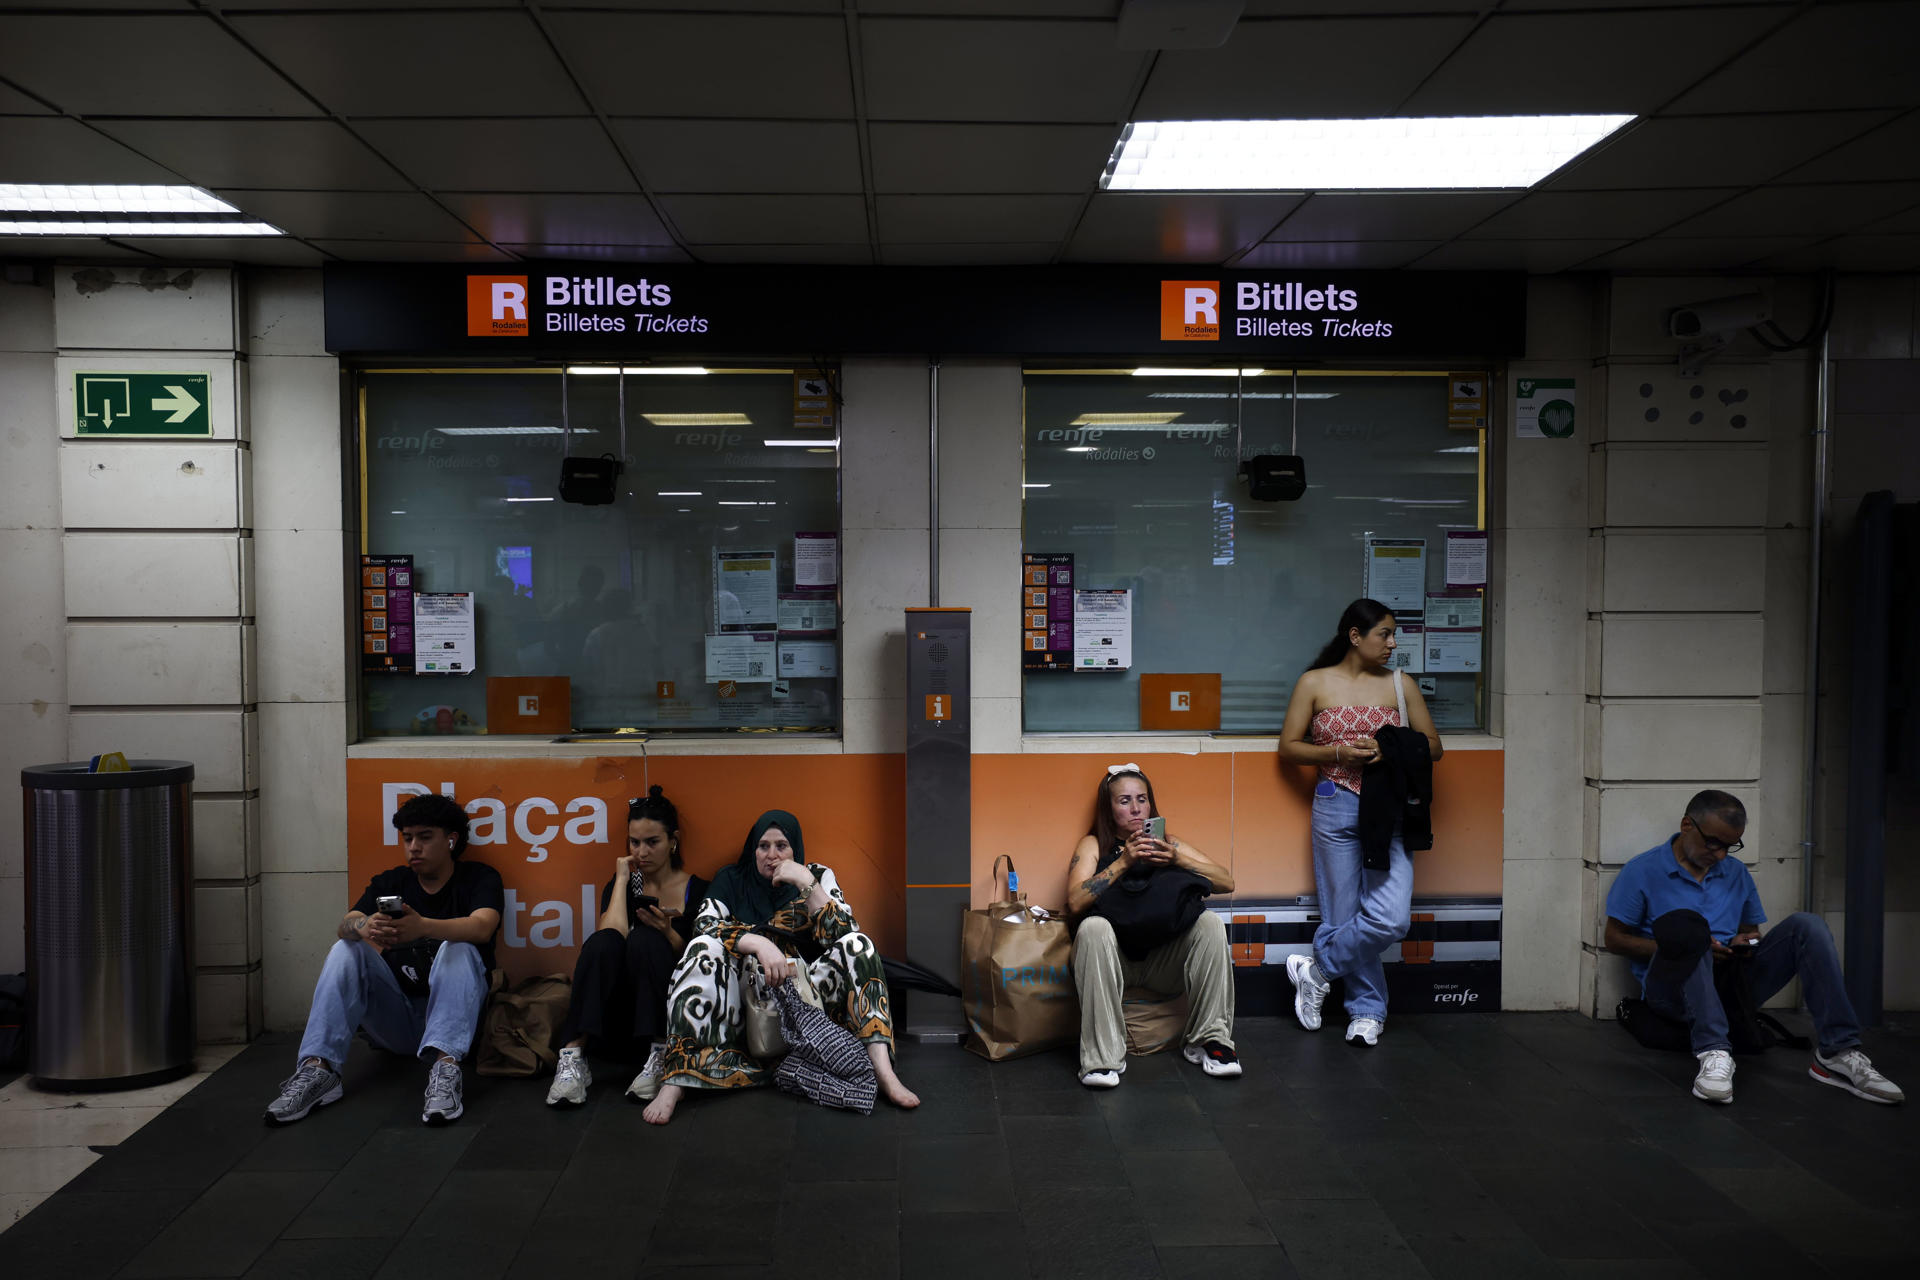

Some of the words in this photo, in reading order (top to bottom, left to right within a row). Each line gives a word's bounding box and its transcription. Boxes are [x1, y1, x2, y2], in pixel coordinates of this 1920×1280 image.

[492, 283, 526, 319] R
[546, 276, 671, 306] Bitllets
[1236, 281, 1357, 311] Bitllets
[1184, 287, 1218, 324] R
[546, 313, 625, 332] Billetes
[635, 313, 708, 333] Tickets
[1184, 326, 1217, 334] Rodalies
[1236, 317, 1313, 337] Billetes
[1322, 318, 1393, 337] Tickets
[377, 429, 445, 456] renfe
[675, 428, 742, 453] renfe
[1037, 424, 1103, 446] renfe
[1166, 419, 1231, 444] renfe
[1086, 447, 1139, 461] Rodalies
[527, 699, 538, 710] R
[1178, 694, 1189, 706] R
[382, 782, 609, 863] Paça
[1434, 988, 1479, 1006] renfe
